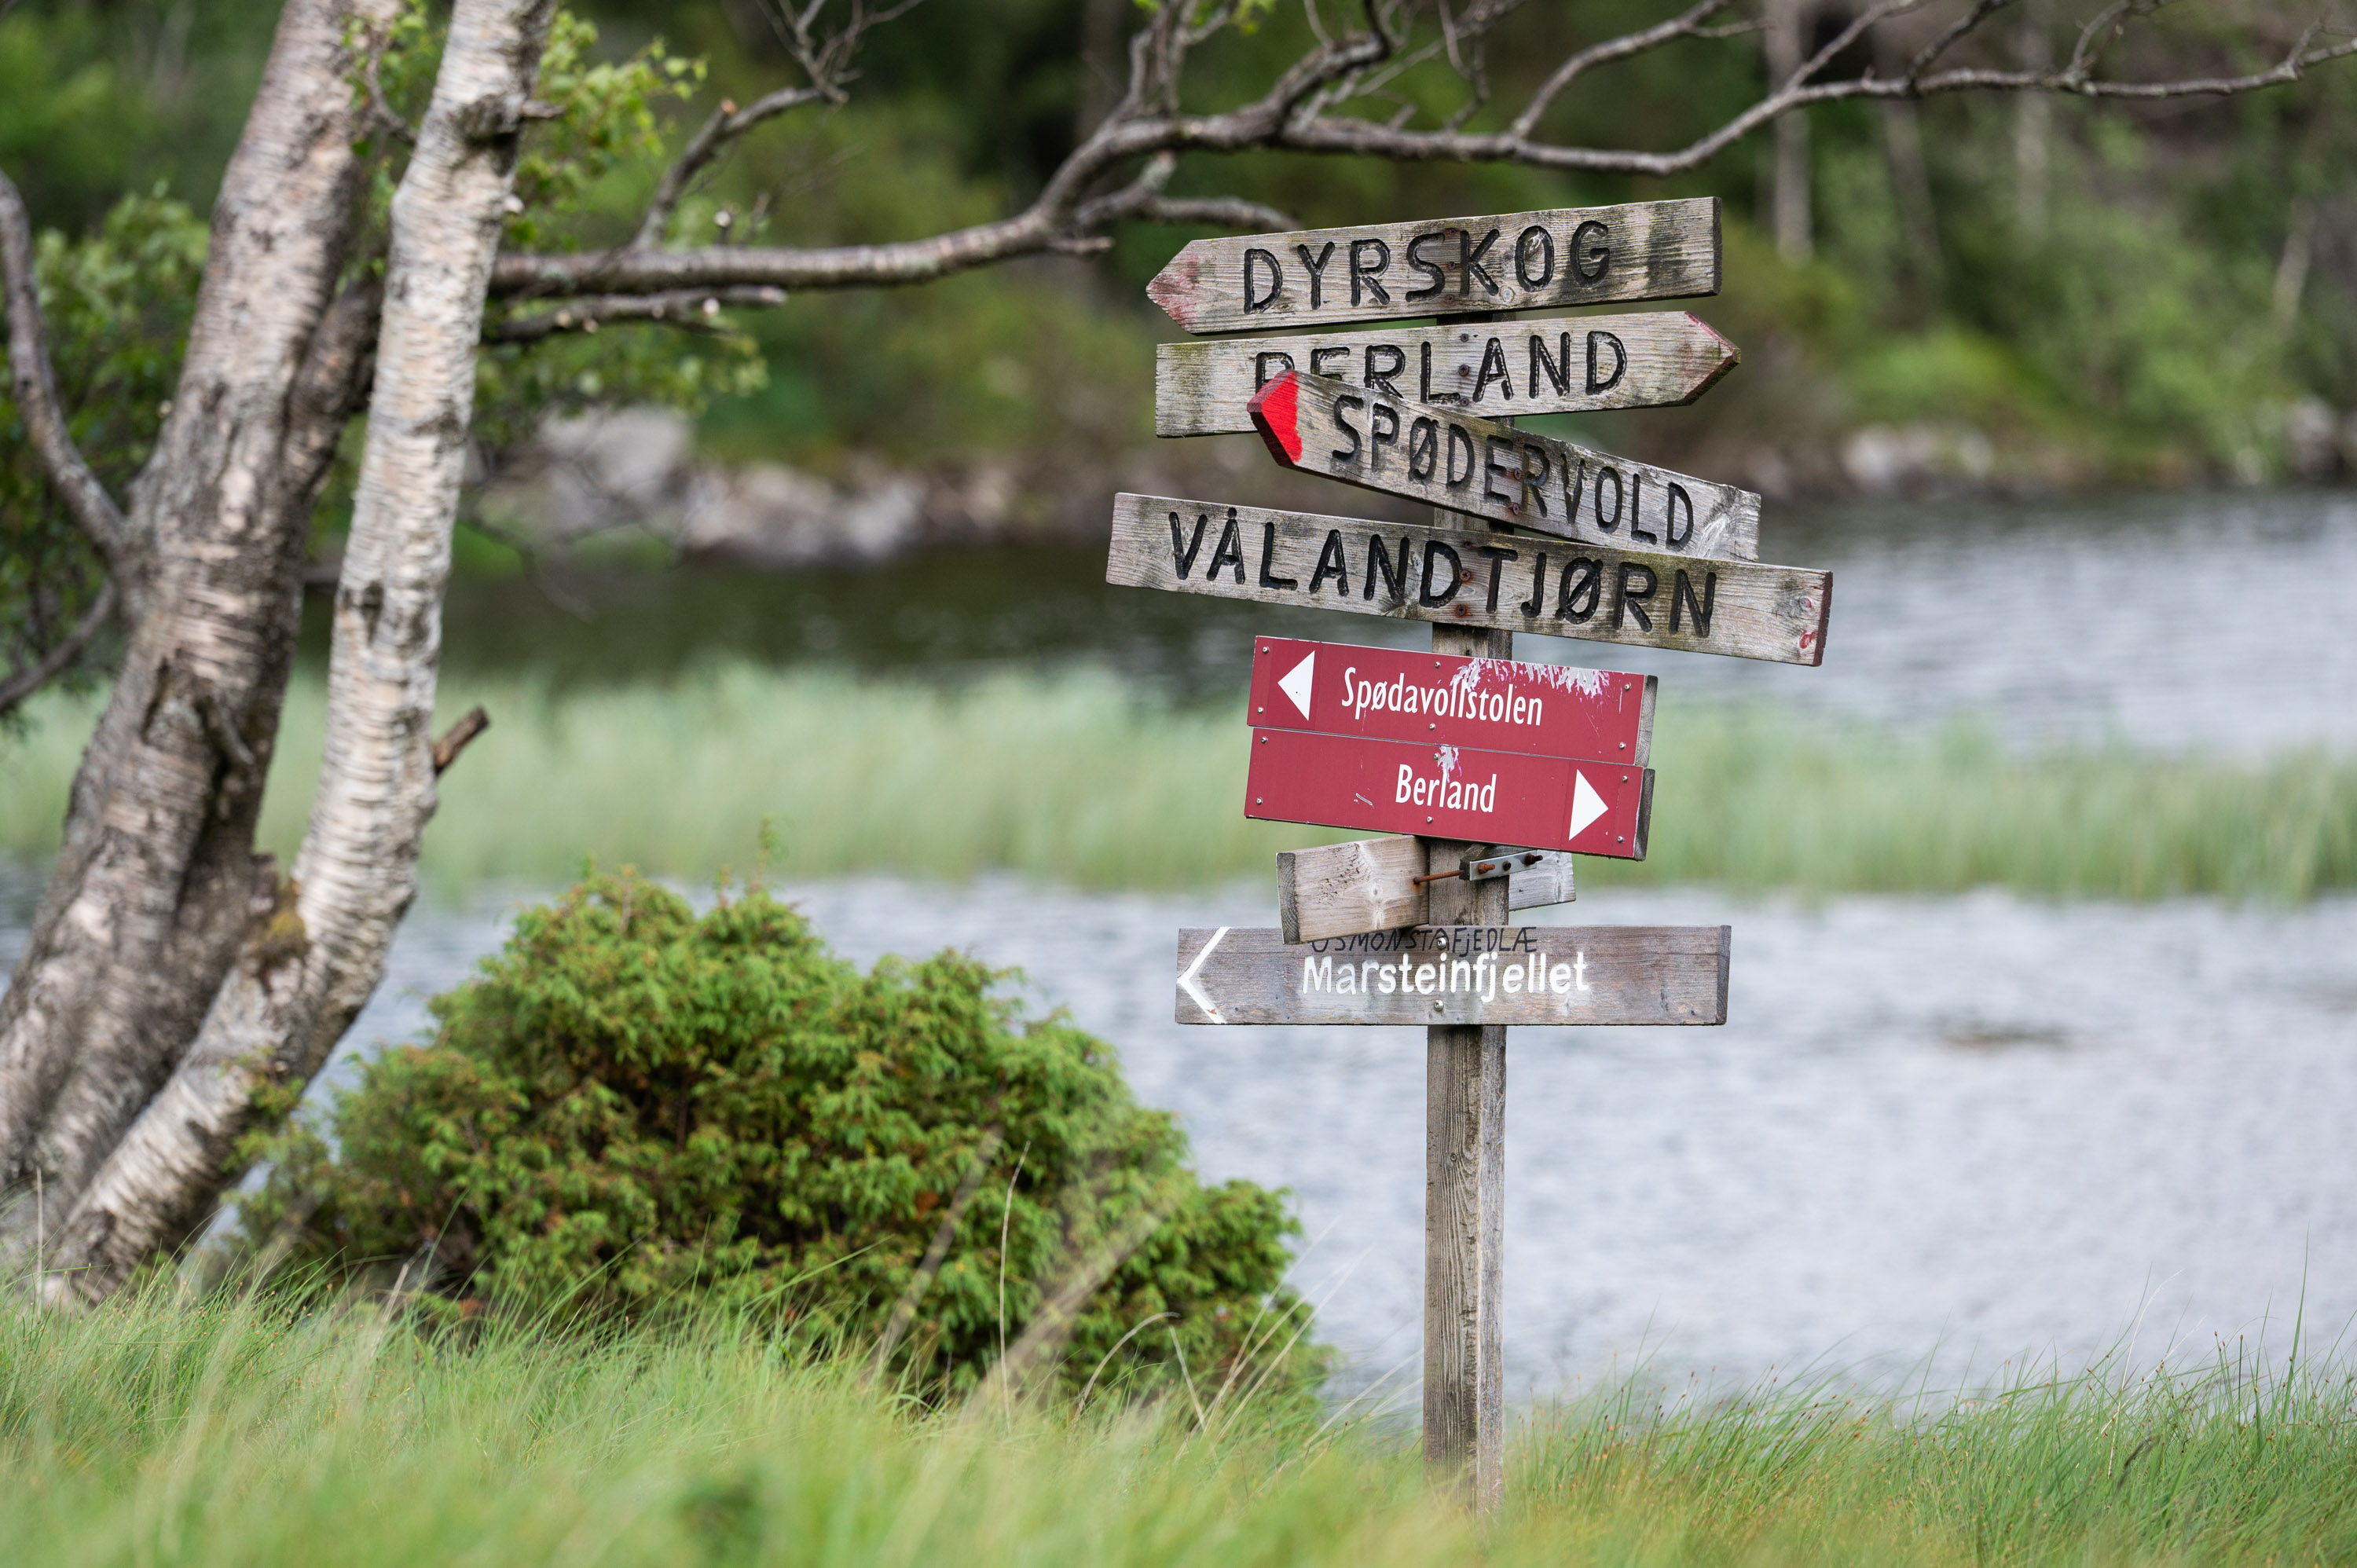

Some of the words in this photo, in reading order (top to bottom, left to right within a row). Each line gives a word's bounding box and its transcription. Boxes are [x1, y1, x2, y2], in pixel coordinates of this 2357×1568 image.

[1244, 222, 1609, 313] DYRSKOG
[1331, 395, 1694, 549] SPØDERVOLD
[1168, 507, 1717, 637] VÅLANDTJØRN
[1341, 666, 1543, 726] Spødavollstolen
[1395, 764, 1497, 813] Berland
[1302, 951, 1589, 1003] Marsteinfjellet
